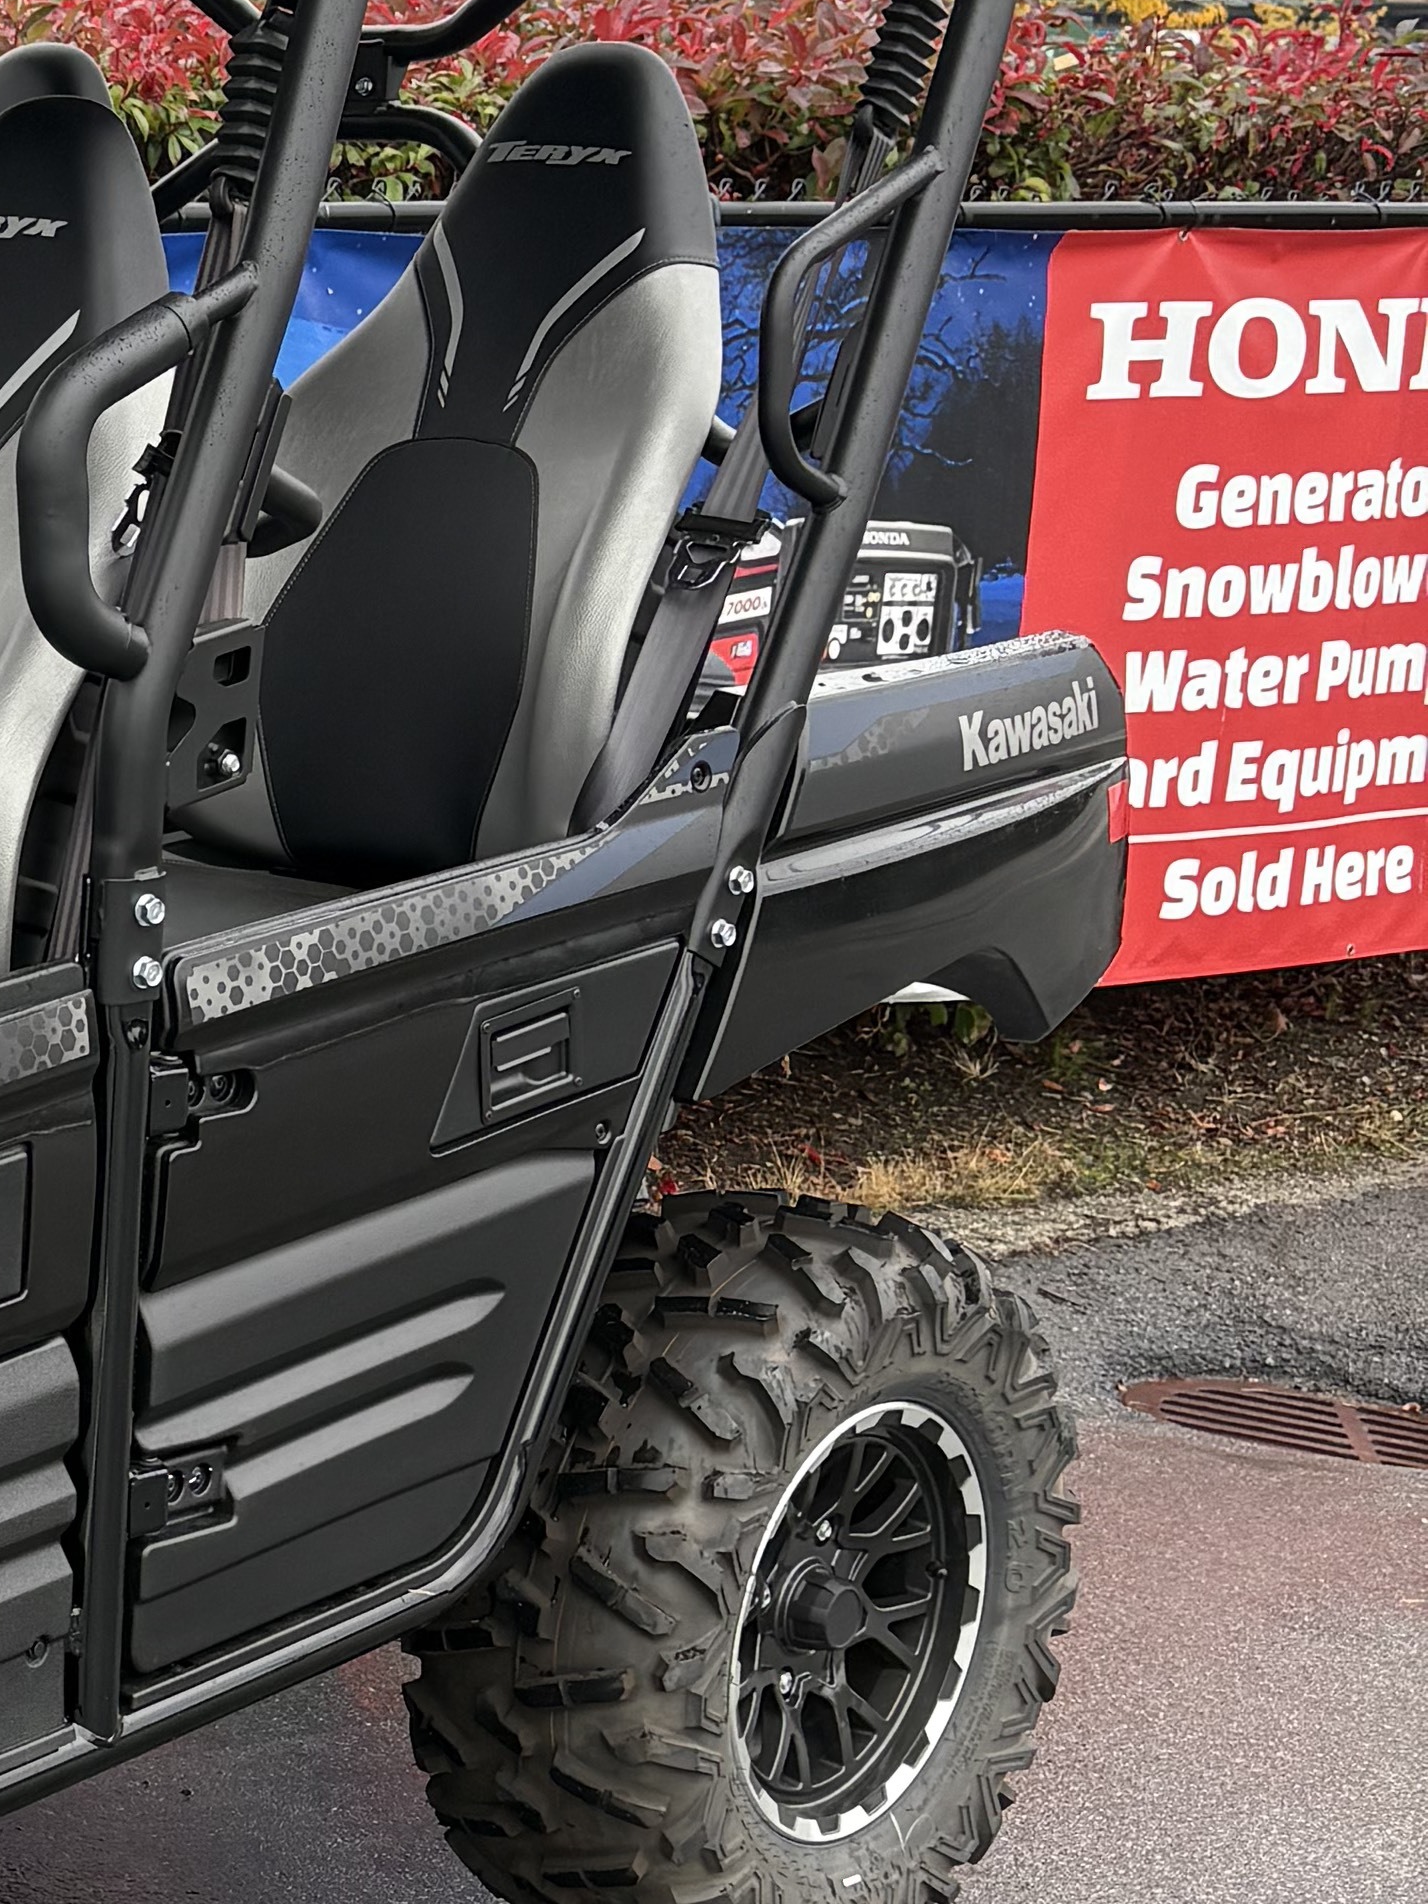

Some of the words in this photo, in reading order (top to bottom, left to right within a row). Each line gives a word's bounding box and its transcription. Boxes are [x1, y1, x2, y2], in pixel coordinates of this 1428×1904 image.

[1086, 297, 1428, 401] HON
[1176, 457, 1428, 529] Generato
[1122, 544, 1428, 621] Snowblow
[1125, 647, 1309, 713] Water
[1315, 639, 1428, 705] Pum
[959, 676, 1099, 771] Kawasaki
[1128, 740, 1219, 809] ard
[1225, 728, 1428, 813] Equipm
[1159, 847, 1294, 919] Sold
[1300, 844, 1414, 906] Here
